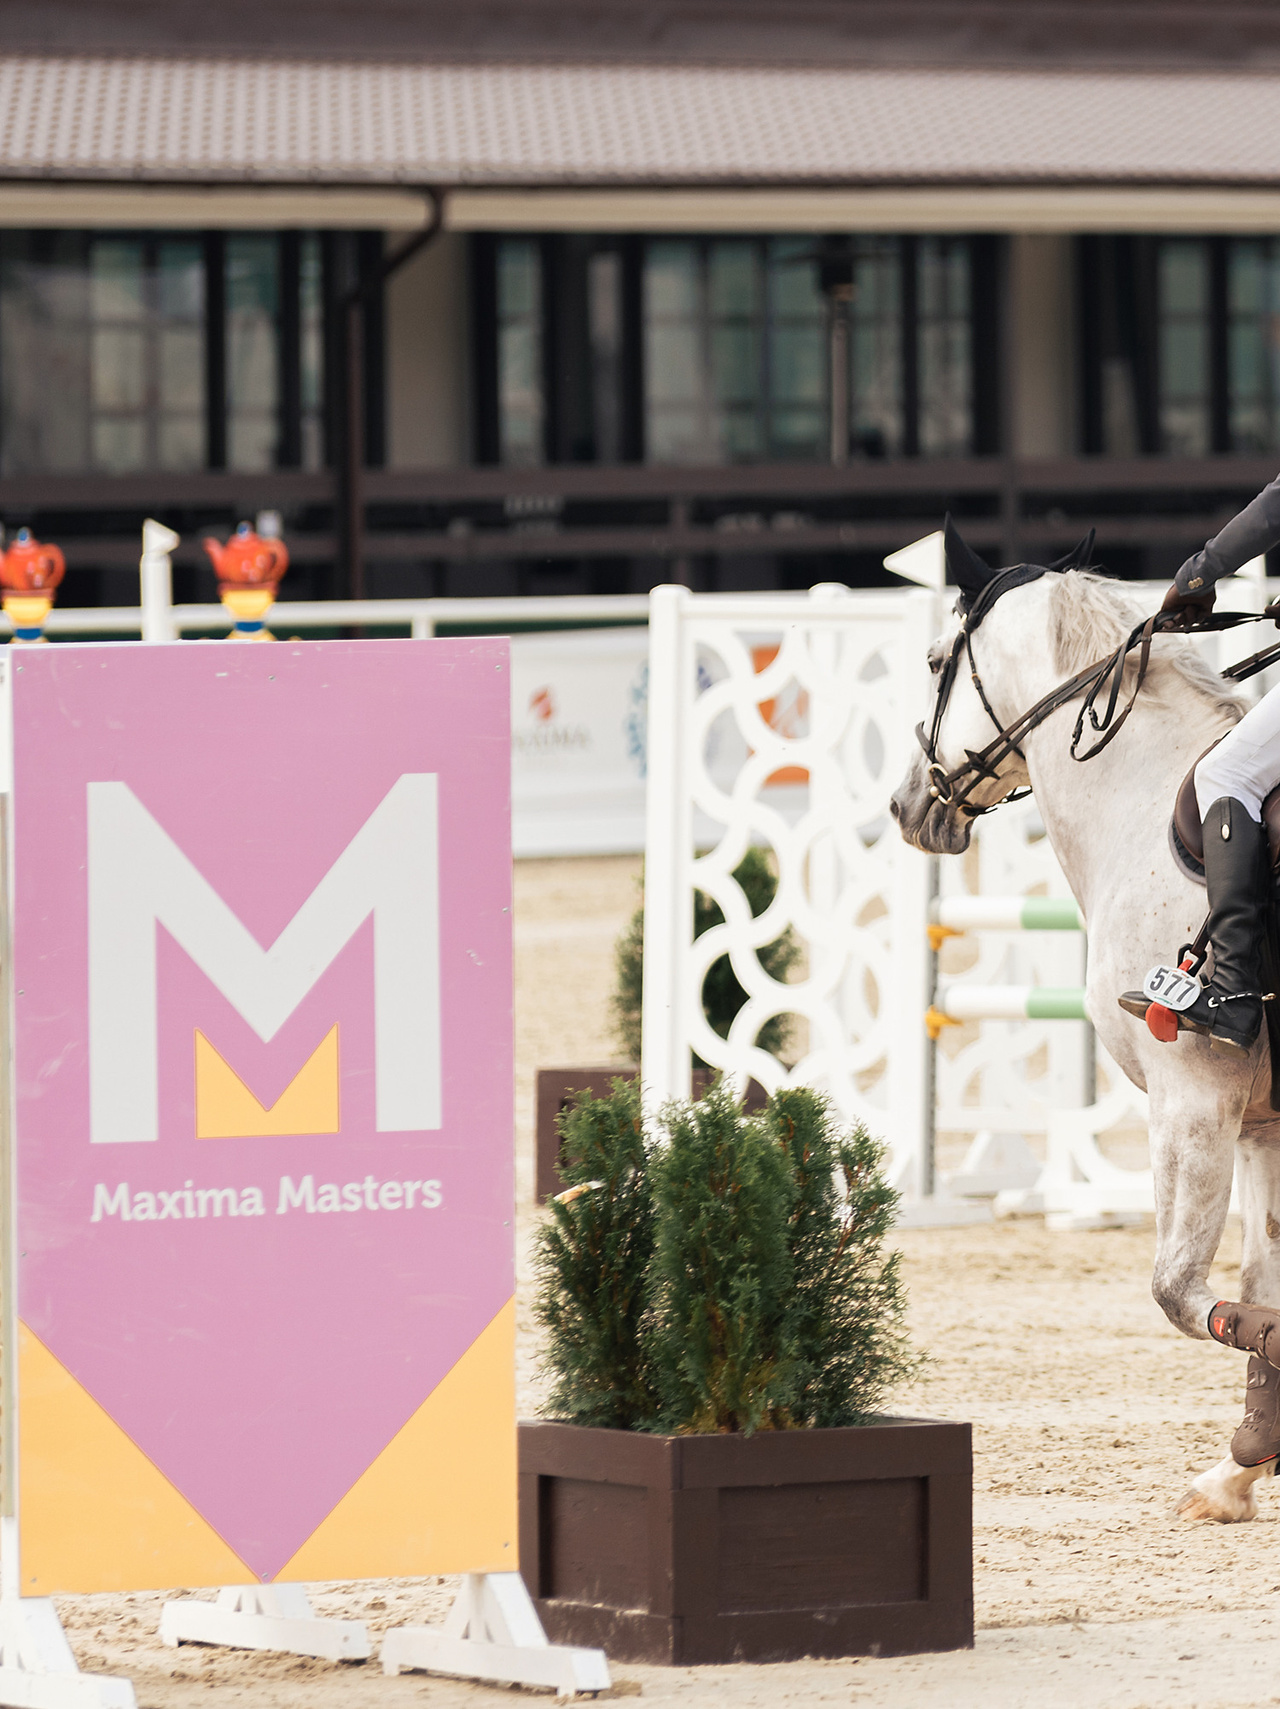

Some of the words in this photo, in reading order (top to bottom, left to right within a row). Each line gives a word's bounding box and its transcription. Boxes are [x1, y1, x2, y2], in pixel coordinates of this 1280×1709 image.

[87, 772, 442, 1143] M
[1150, 967, 1196, 1002] 577
[90, 1179, 266, 1222] Maxima
[276, 1174, 443, 1215] Masters
